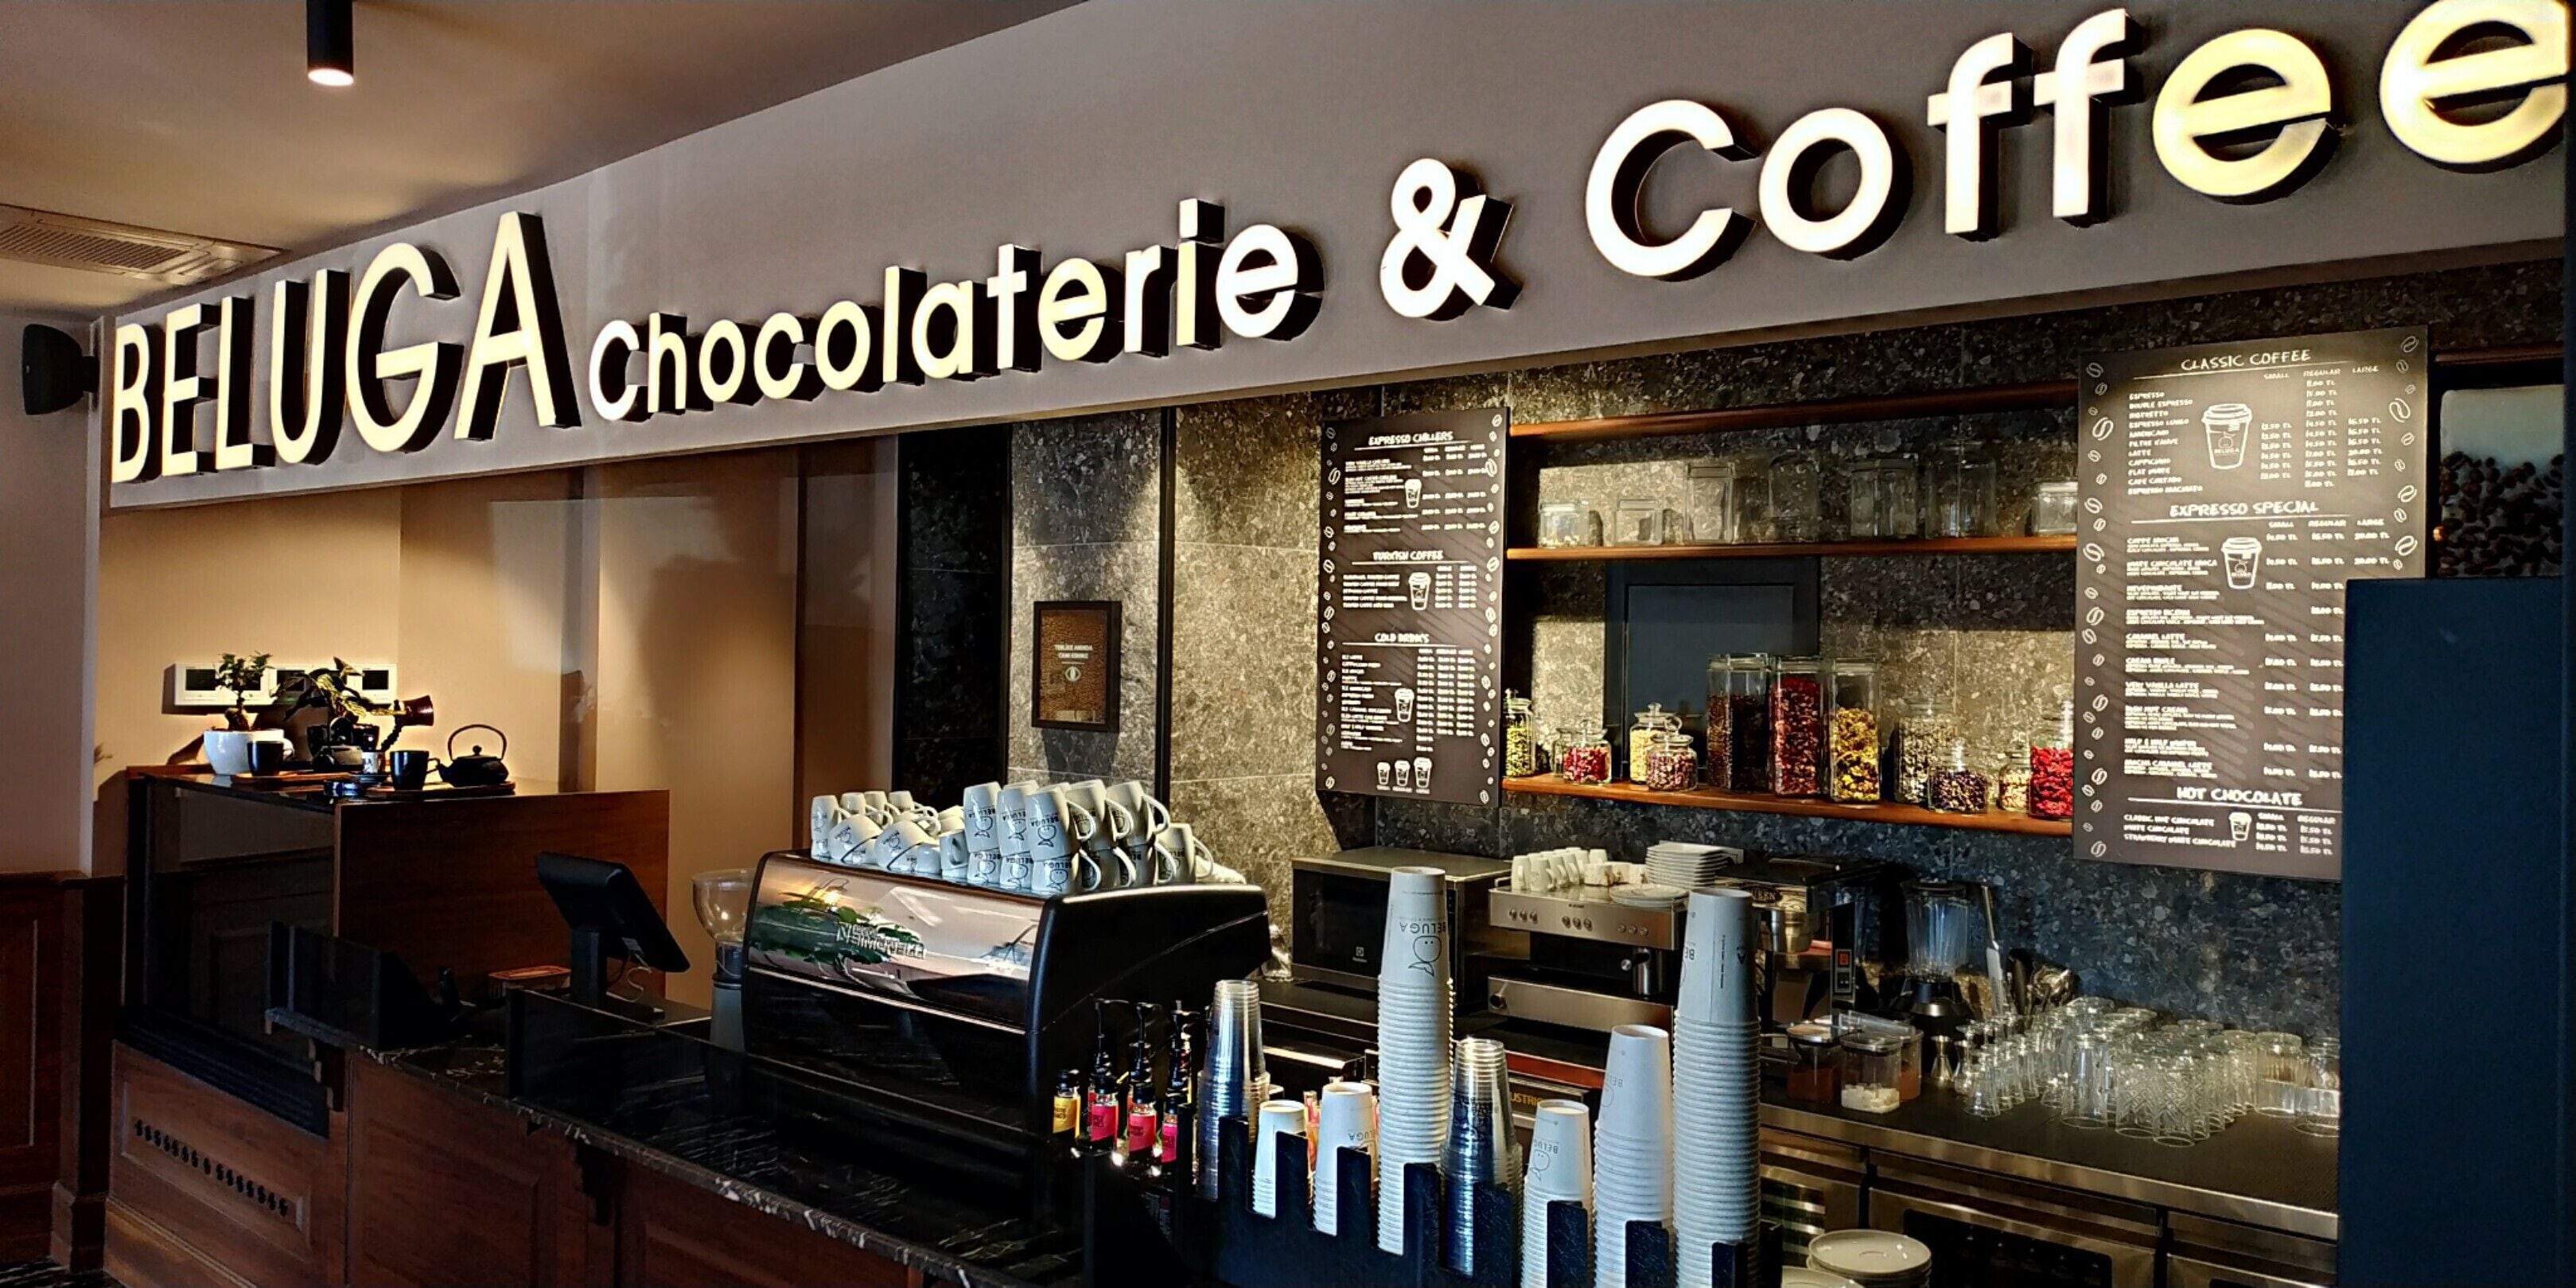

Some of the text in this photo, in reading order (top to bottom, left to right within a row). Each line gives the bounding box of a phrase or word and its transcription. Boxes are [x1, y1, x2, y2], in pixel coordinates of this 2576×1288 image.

[111, 0, 2568, 484] BELUGA Chocolaterie & Coffee
[2181, 349, 2311, 371] CLASSIC COFFEE
[1368, 431, 1453, 446] EXPRESSO CHILLERS
[2169, 500, 2319, 517] EXPRESSO SPECIAL
[1410, 550, 1444, 560] COFFEE
[1375, 632, 1396, 643] COLD
[2177, 787, 2303, 806] HOT CHOCOLATE
